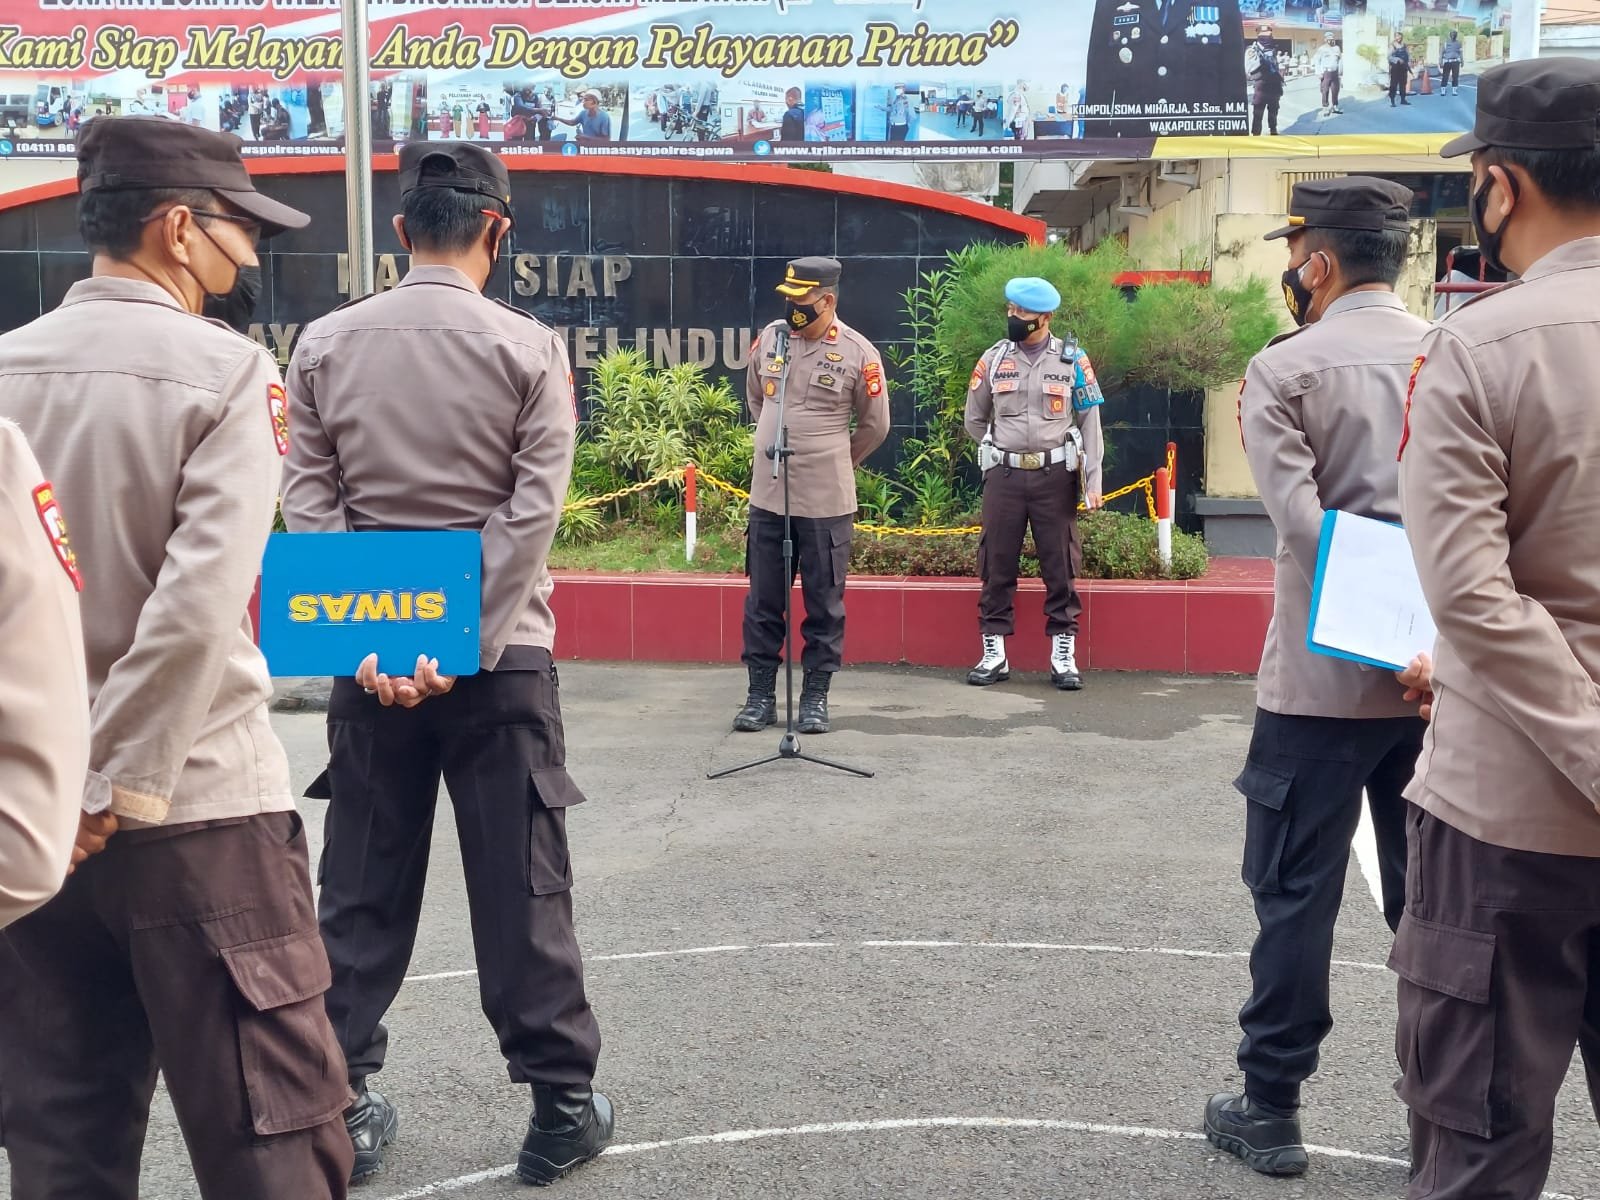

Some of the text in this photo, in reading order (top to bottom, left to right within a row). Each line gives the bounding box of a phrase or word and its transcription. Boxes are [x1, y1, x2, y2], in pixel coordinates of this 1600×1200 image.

[94, 27, 176, 77] Siap
[185, 27, 345, 79] Melayan
[371, 24, 480, 69] Anda
[487, 24, 639, 78] Dengan
[643, 23, 852, 78] Pelayanan
[1072, 104, 1112, 116] KOMPOL
[1114, 103, 1142, 115] SOMA
[1225, 101, 1247, 113] M.M.
[1150, 119, 1247, 132] WAKAPOLRES GOWA
[773, 145, 1023, 156] www.tribratanewspolresgowa.com
[514, 253, 632, 298] SIAP
[816, 361, 847, 375] POLRI
[1043, 373, 1071, 384] POLRI
[289, 592, 447, 623] SIWAS
